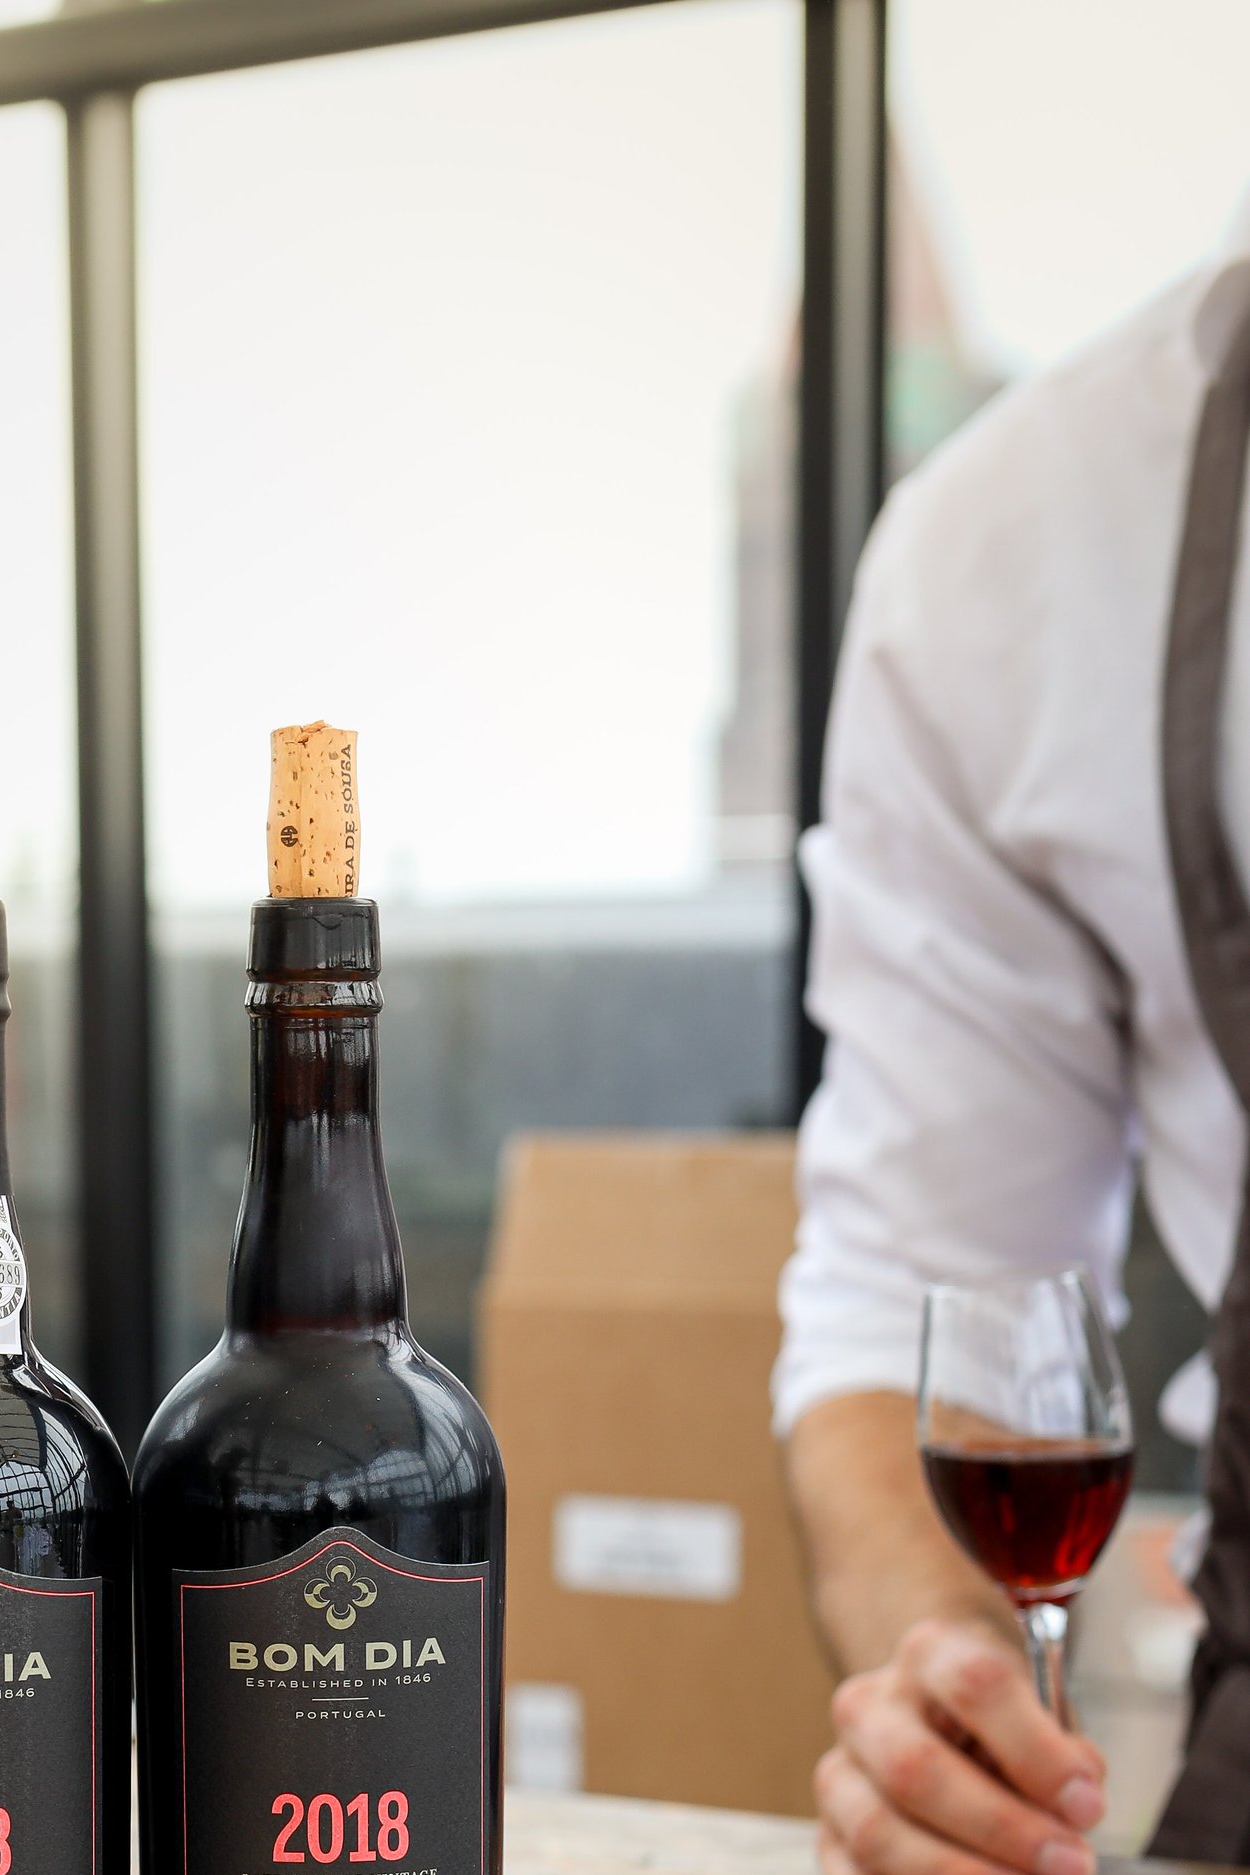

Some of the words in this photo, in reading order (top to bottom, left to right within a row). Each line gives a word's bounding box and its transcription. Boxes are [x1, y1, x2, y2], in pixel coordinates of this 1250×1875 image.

[345, 820, 356, 851] DE
[344, 856, 355, 897] IRA
[229, 1641, 345, 1672] BOM
[365, 1637, 447, 1669] DIA
[246, 1677, 364, 1689] ESTABLISHED
[372, 1678, 387, 1687] IN
[395, 1672, 431, 1685] 1846
[295, 1709, 386, 1720] PORTUGAL
[271, 1790, 410, 1864] 2018
